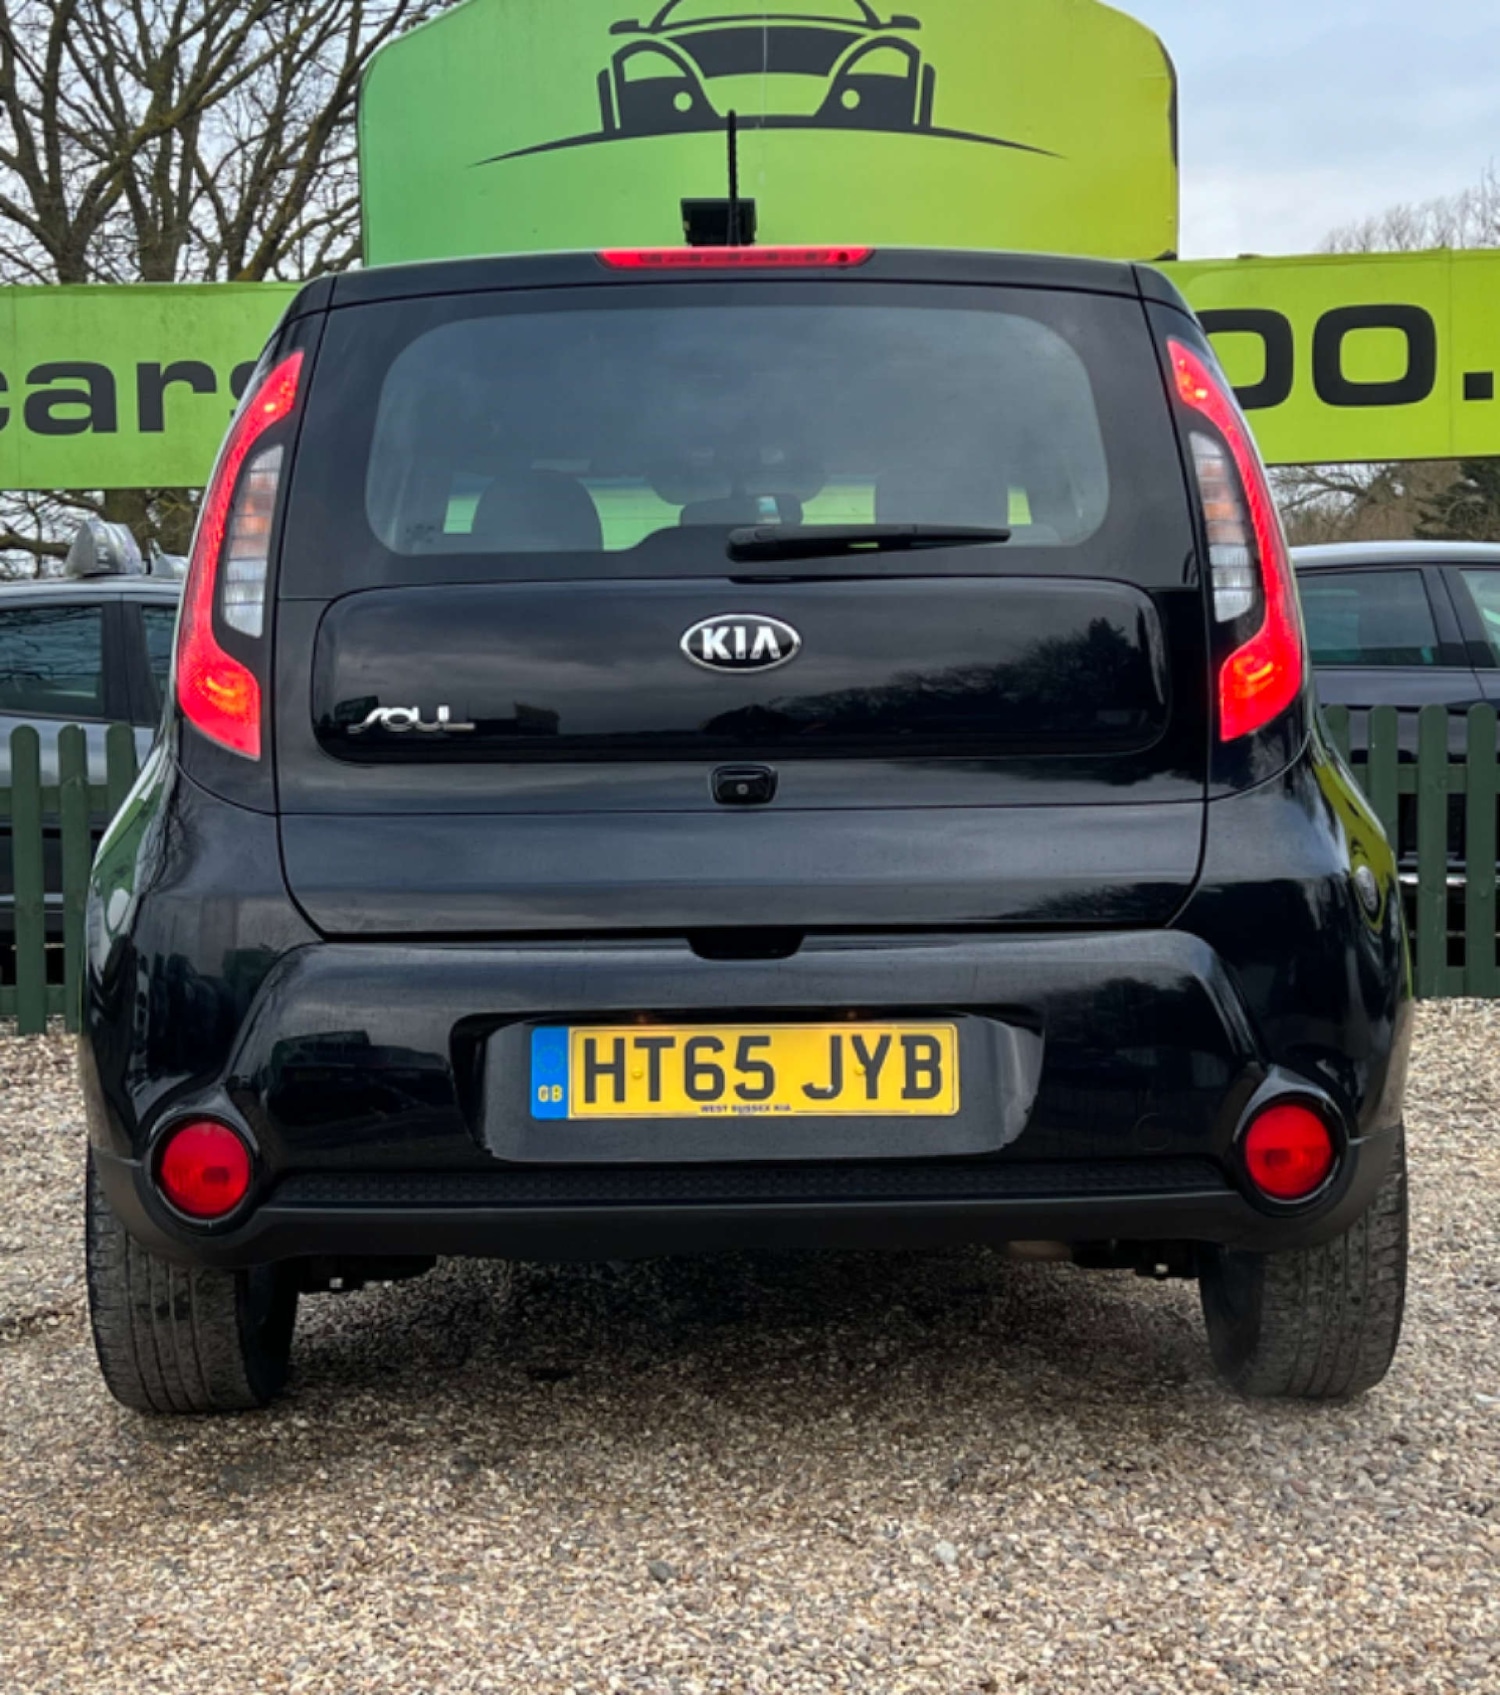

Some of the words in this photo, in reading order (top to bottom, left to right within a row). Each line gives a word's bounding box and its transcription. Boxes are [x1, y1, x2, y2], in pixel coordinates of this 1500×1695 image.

[702, 626, 783, 660] KIA
[347, 705, 475, 733] SOUL
[583, 1036, 776, 1103] HT65
[801, 1034, 943, 1099] JYB
[537, 1085, 563, 1102] GB
[701, 1104, 728, 1113] WEST
[773, 1103, 791, 1111] KIA
